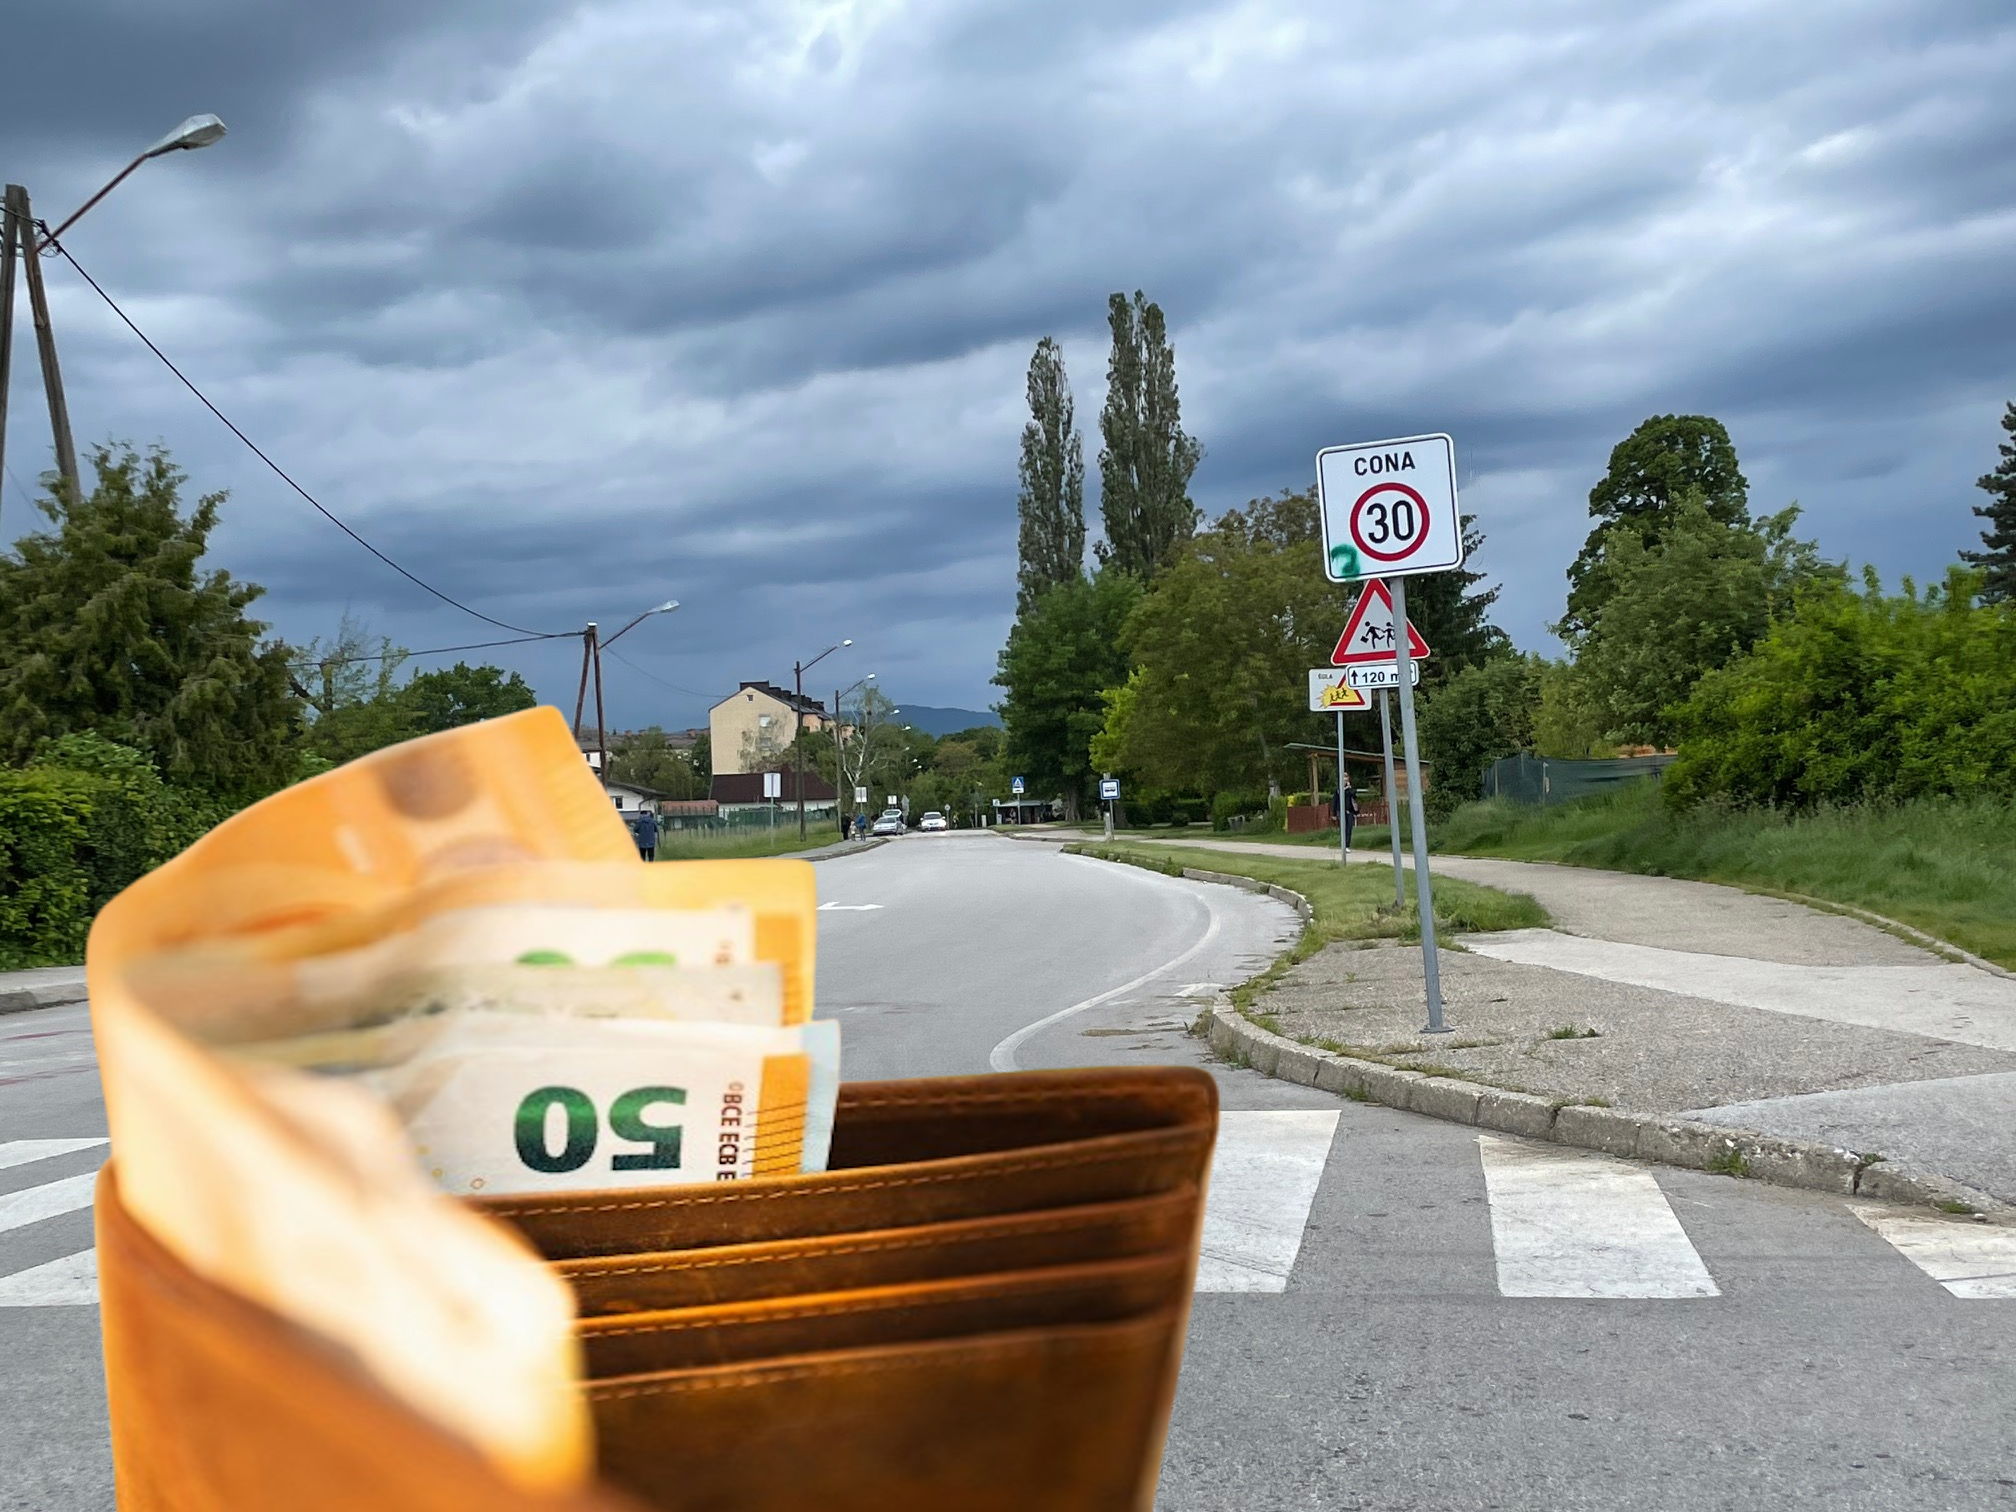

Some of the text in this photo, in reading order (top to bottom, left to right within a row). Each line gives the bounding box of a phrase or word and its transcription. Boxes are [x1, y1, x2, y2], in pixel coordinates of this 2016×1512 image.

[1354, 451, 1416, 476] CONA
[1366, 500, 1415, 544] 30
[1361, 671, 1385, 684] 120
[514, 1086, 688, 1173] 50
[718, 1133, 740, 1165] ECB
